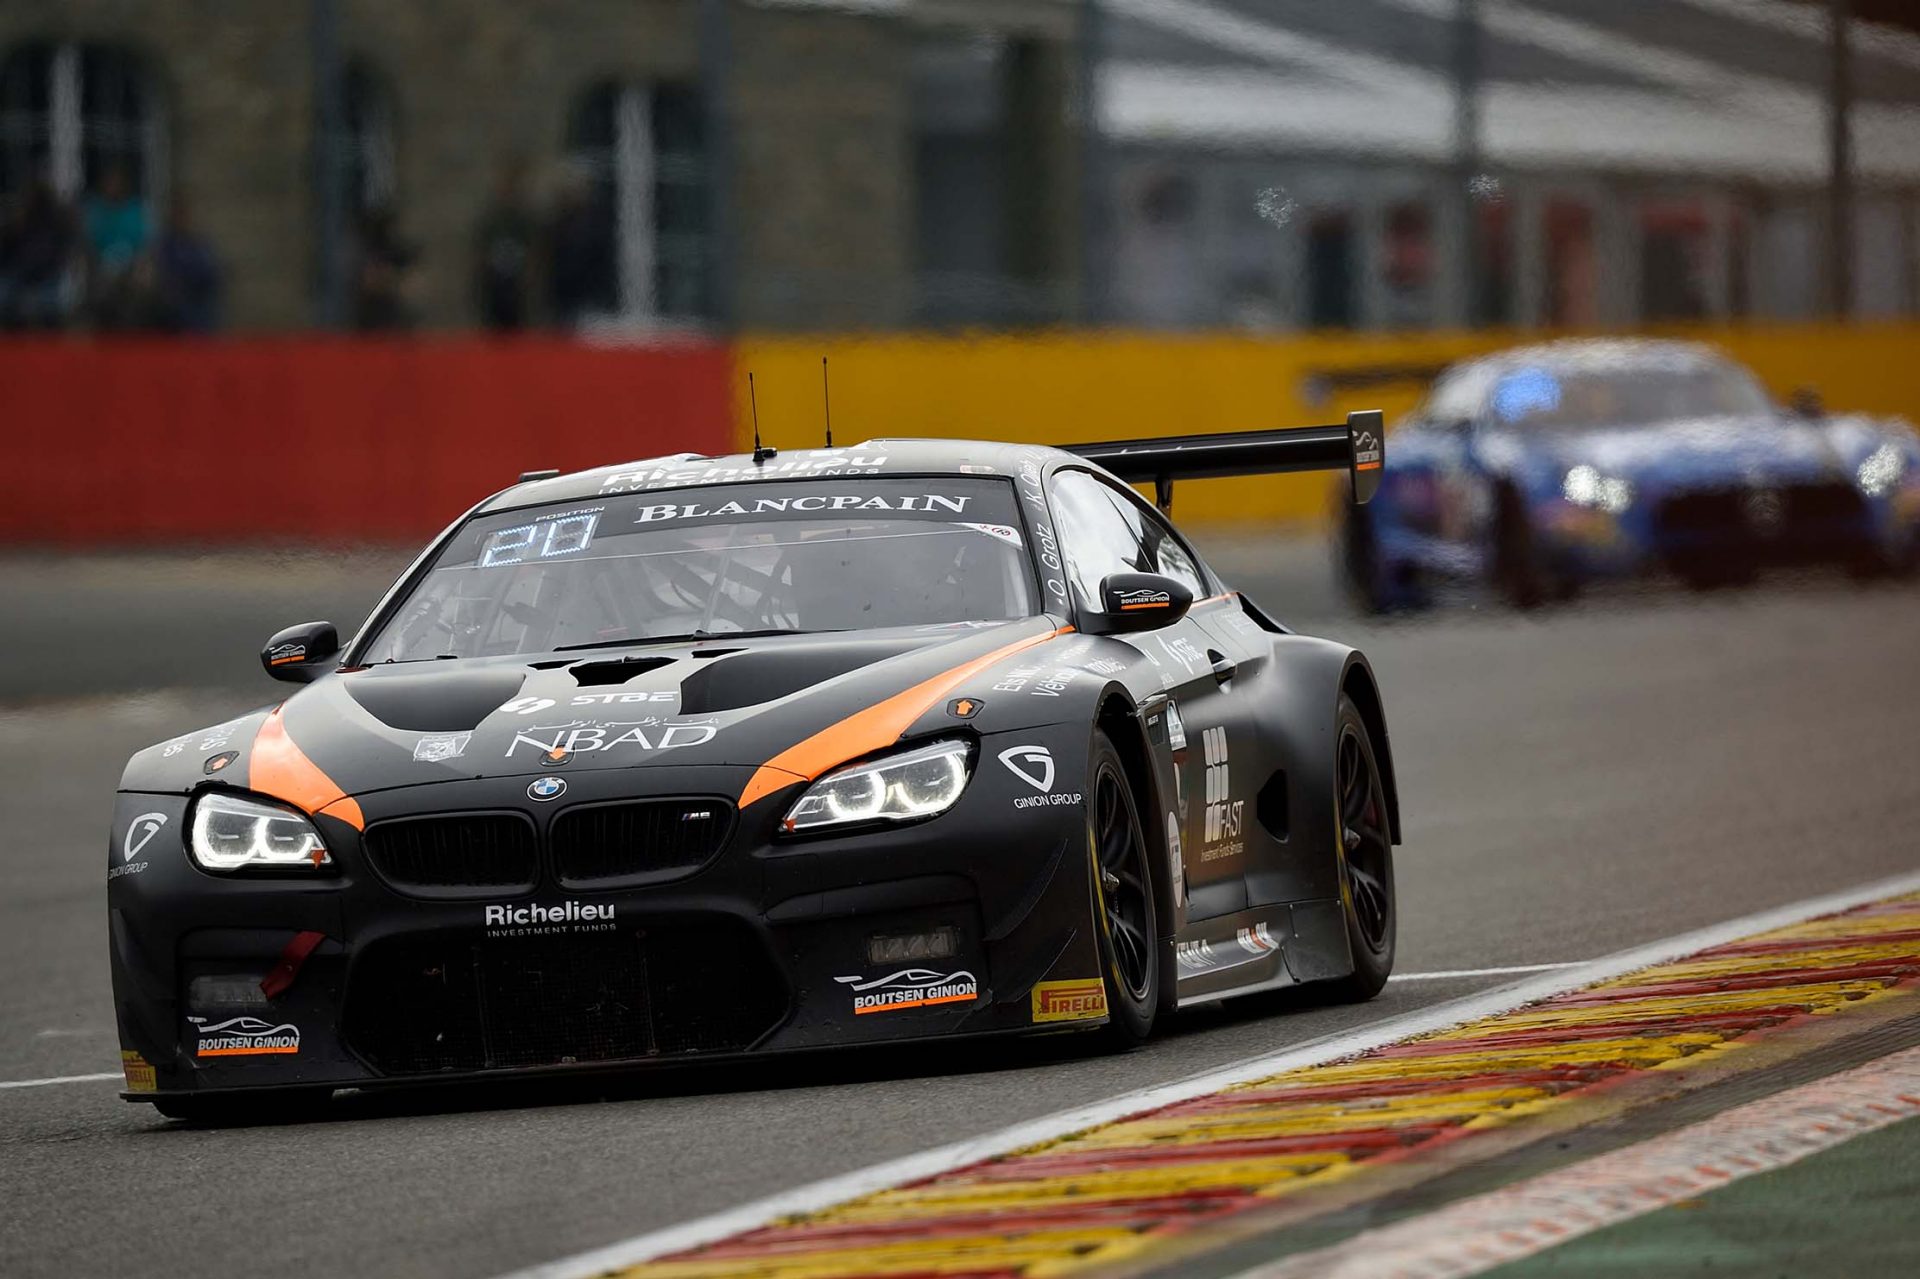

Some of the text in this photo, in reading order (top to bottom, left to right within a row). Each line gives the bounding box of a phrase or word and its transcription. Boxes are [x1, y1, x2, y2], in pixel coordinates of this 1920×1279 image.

[602, 456, 888, 487] Richelieu
[535, 506, 605, 522] POSITION
[633, 494, 972, 523] BLANCPAIN
[482, 515, 597, 567] 20
[1036, 522, 1060, 570] Grotz
[570, 691, 678, 706] STBE
[504, 726, 718, 757] NBAD
[1013, 793, 1082, 809] GINION GROUP
[485, 901, 615, 926] Richelieu
[487, 923, 617, 938] INVESTMENT FUNDS
[854, 982, 977, 1009] BOUTSEN GINION
[1041, 986, 1105, 1014] PIRELLI
[198, 1036, 300, 1051] BOUTSEN GINION
